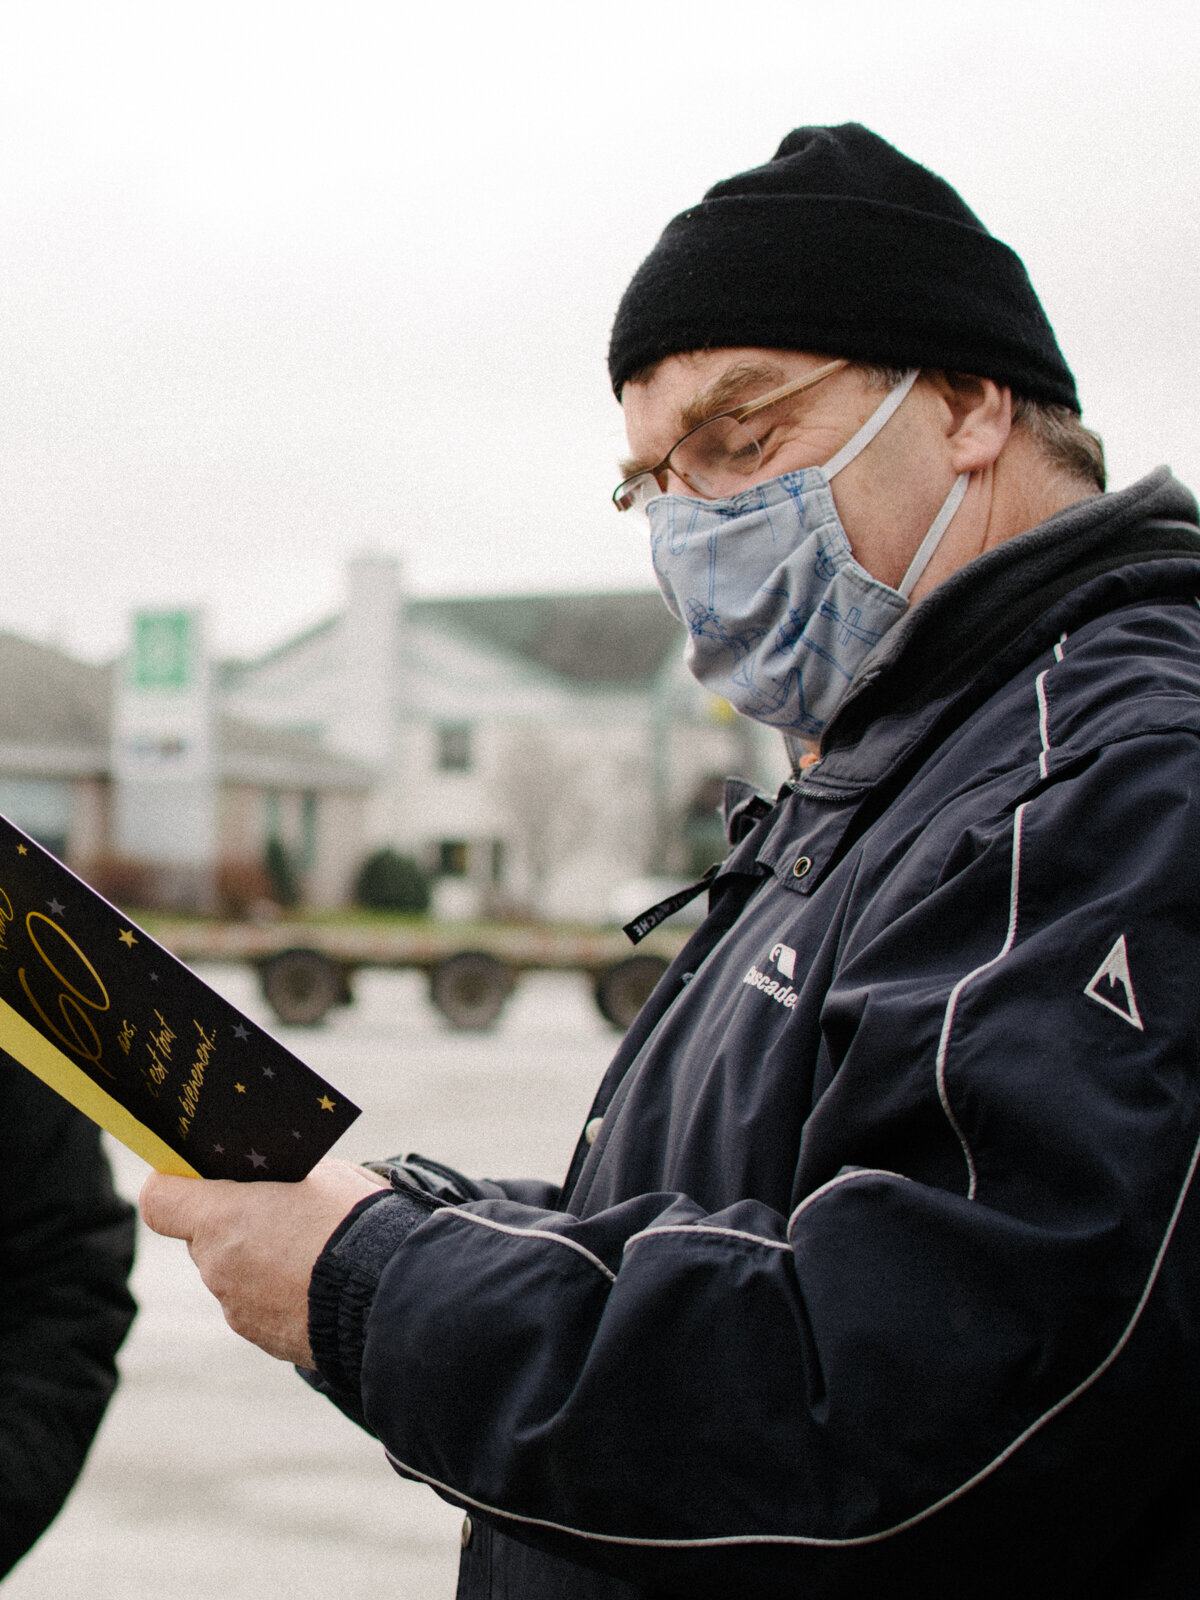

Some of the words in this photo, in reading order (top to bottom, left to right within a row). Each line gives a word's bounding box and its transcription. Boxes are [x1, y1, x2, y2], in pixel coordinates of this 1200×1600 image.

[17, 911, 117, 1080] 60
[149, 1008, 178, 1062] tout
[140, 1043, 169, 1098] c'est
[177, 1116, 192, 1141] un
